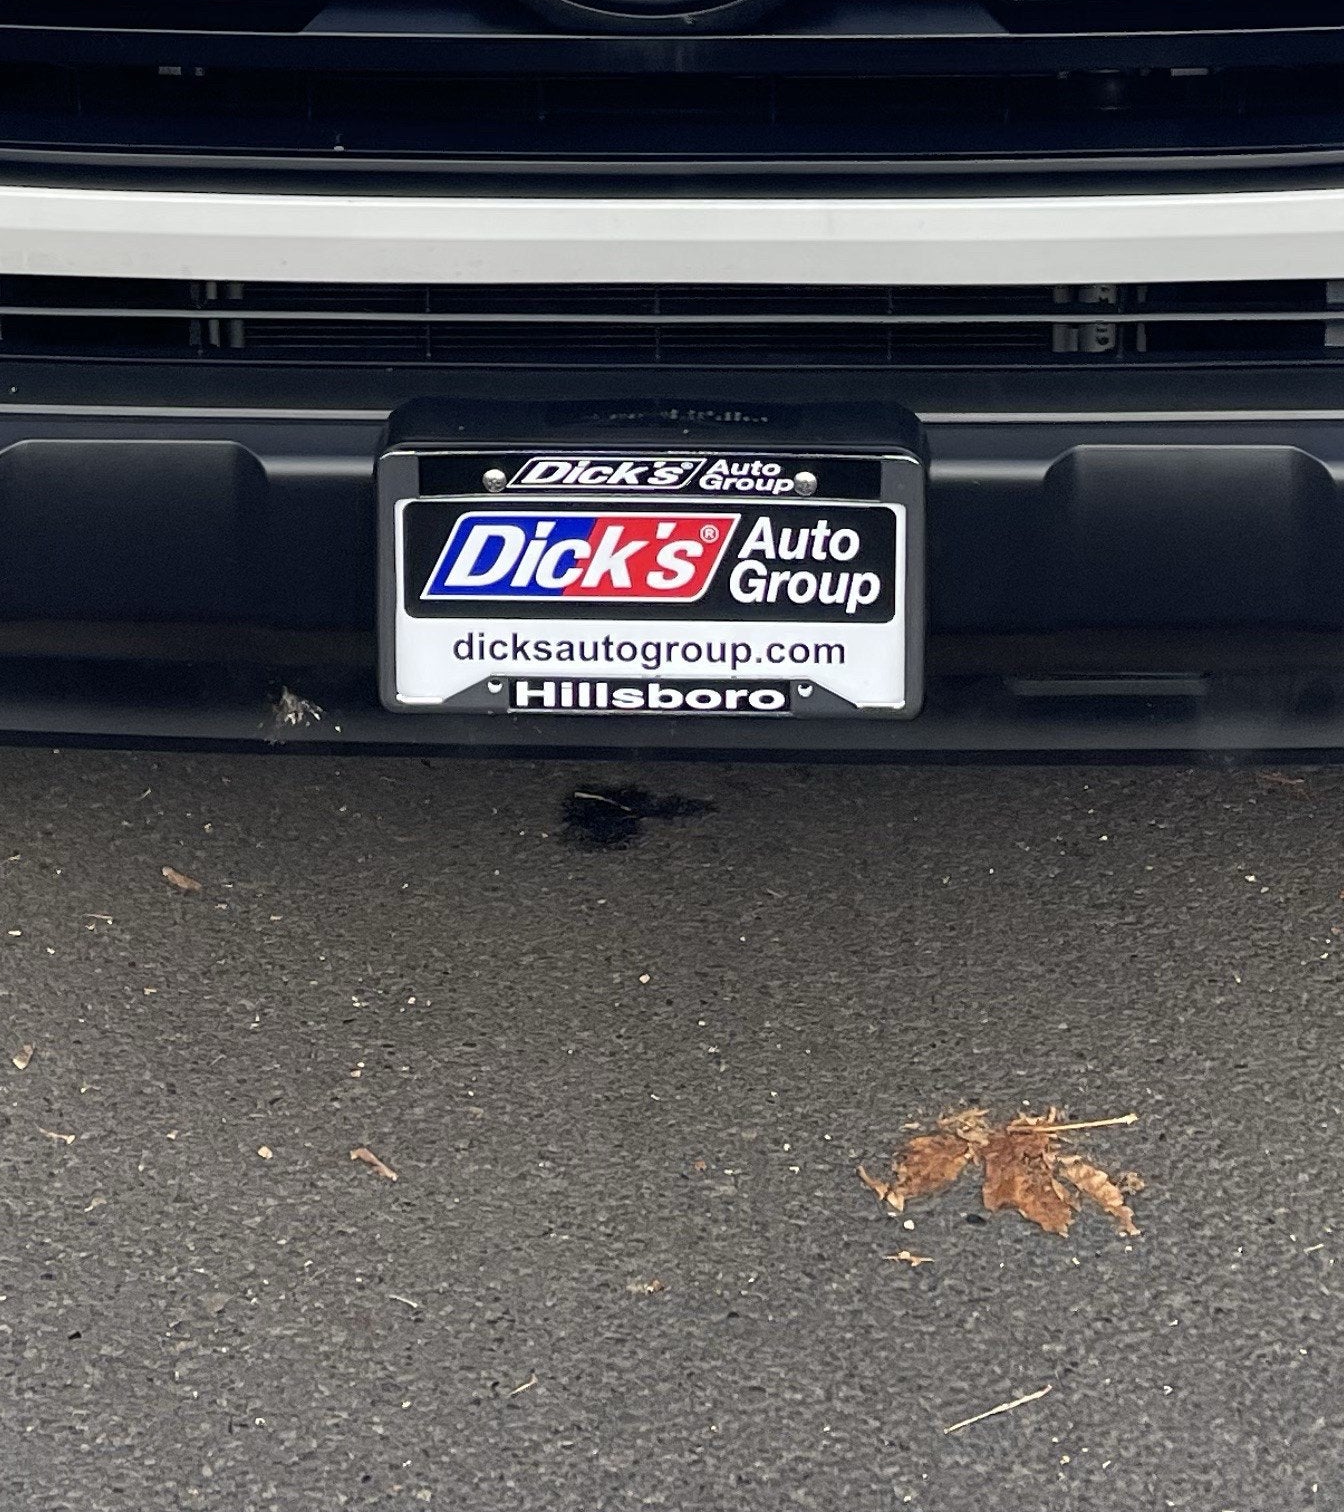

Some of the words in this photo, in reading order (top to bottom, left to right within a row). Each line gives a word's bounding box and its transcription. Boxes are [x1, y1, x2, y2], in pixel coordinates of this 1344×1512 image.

[520, 461, 694, 485] Dick's
[706, 459, 781, 476] Auto
[698, 474, 795, 495] Group
[444, 521, 704, 590] Dick's
[737, 516, 860, 561] Auto
[729, 559, 881, 614] Group
[453, 632, 845, 671] dicksautogroup.com
[516, 680, 786, 710] Hillsboro
